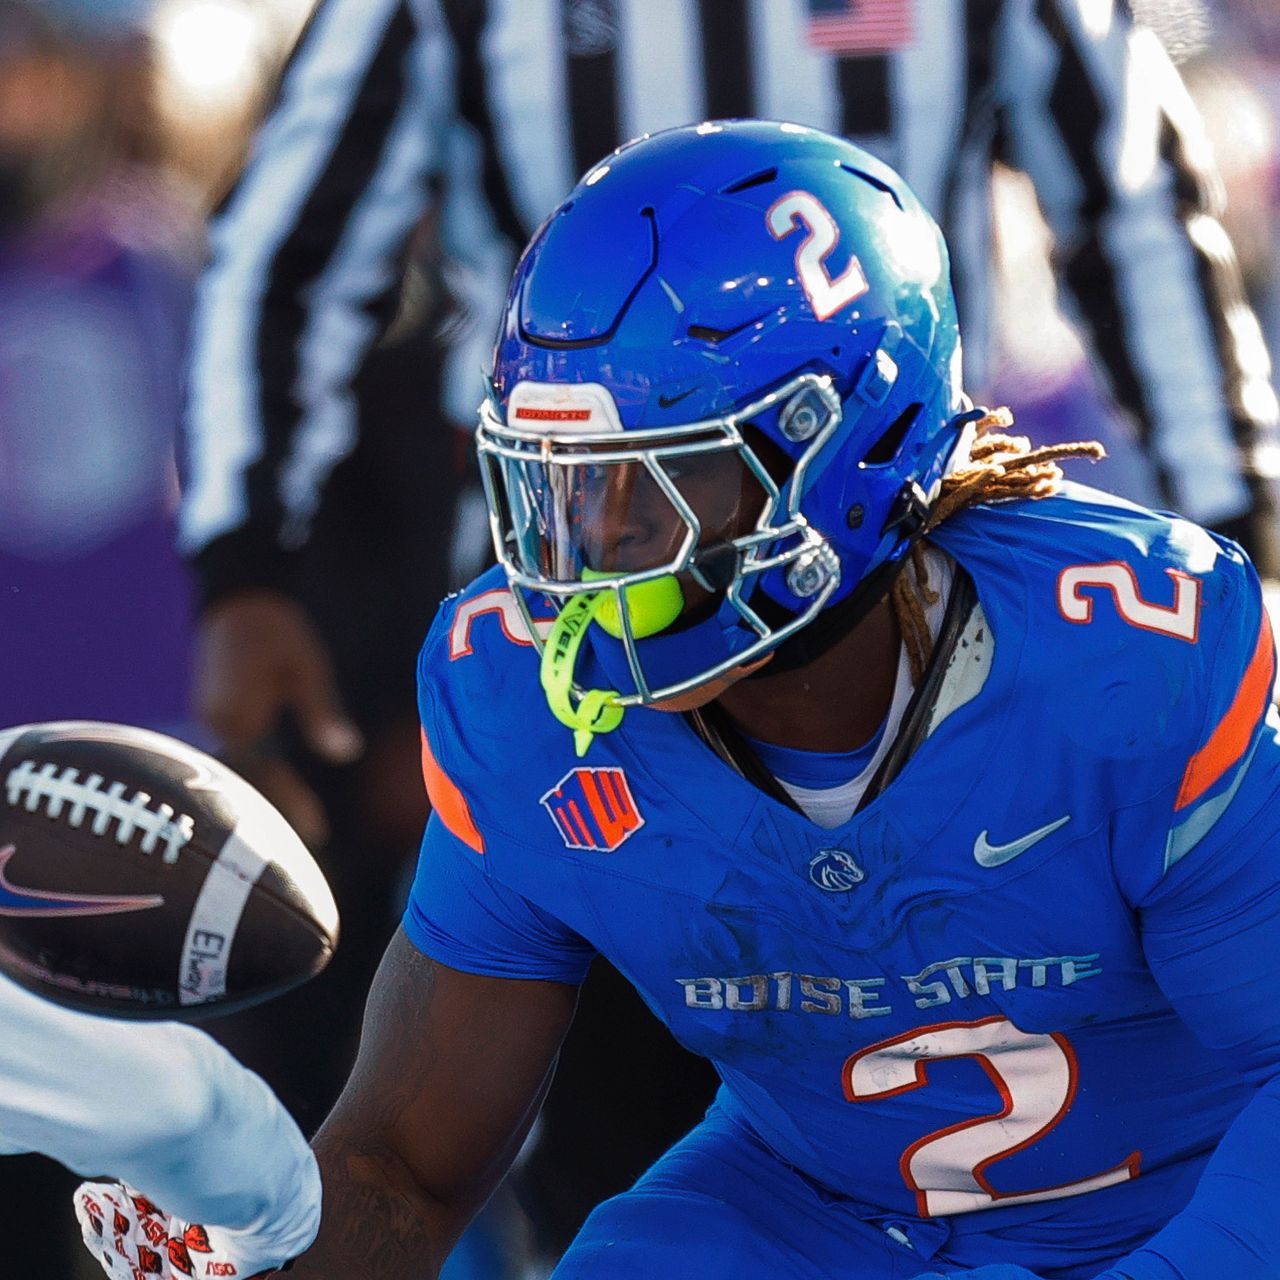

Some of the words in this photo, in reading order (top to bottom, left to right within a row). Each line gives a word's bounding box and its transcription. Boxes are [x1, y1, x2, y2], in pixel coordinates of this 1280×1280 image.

[765, 189, 869, 322] 2
[1056, 560, 1203, 644] 2
[675, 972, 892, 1019] BOISE
[901, 953, 1102, 1009] STATE
[841, 1015, 1141, 1218] 2
